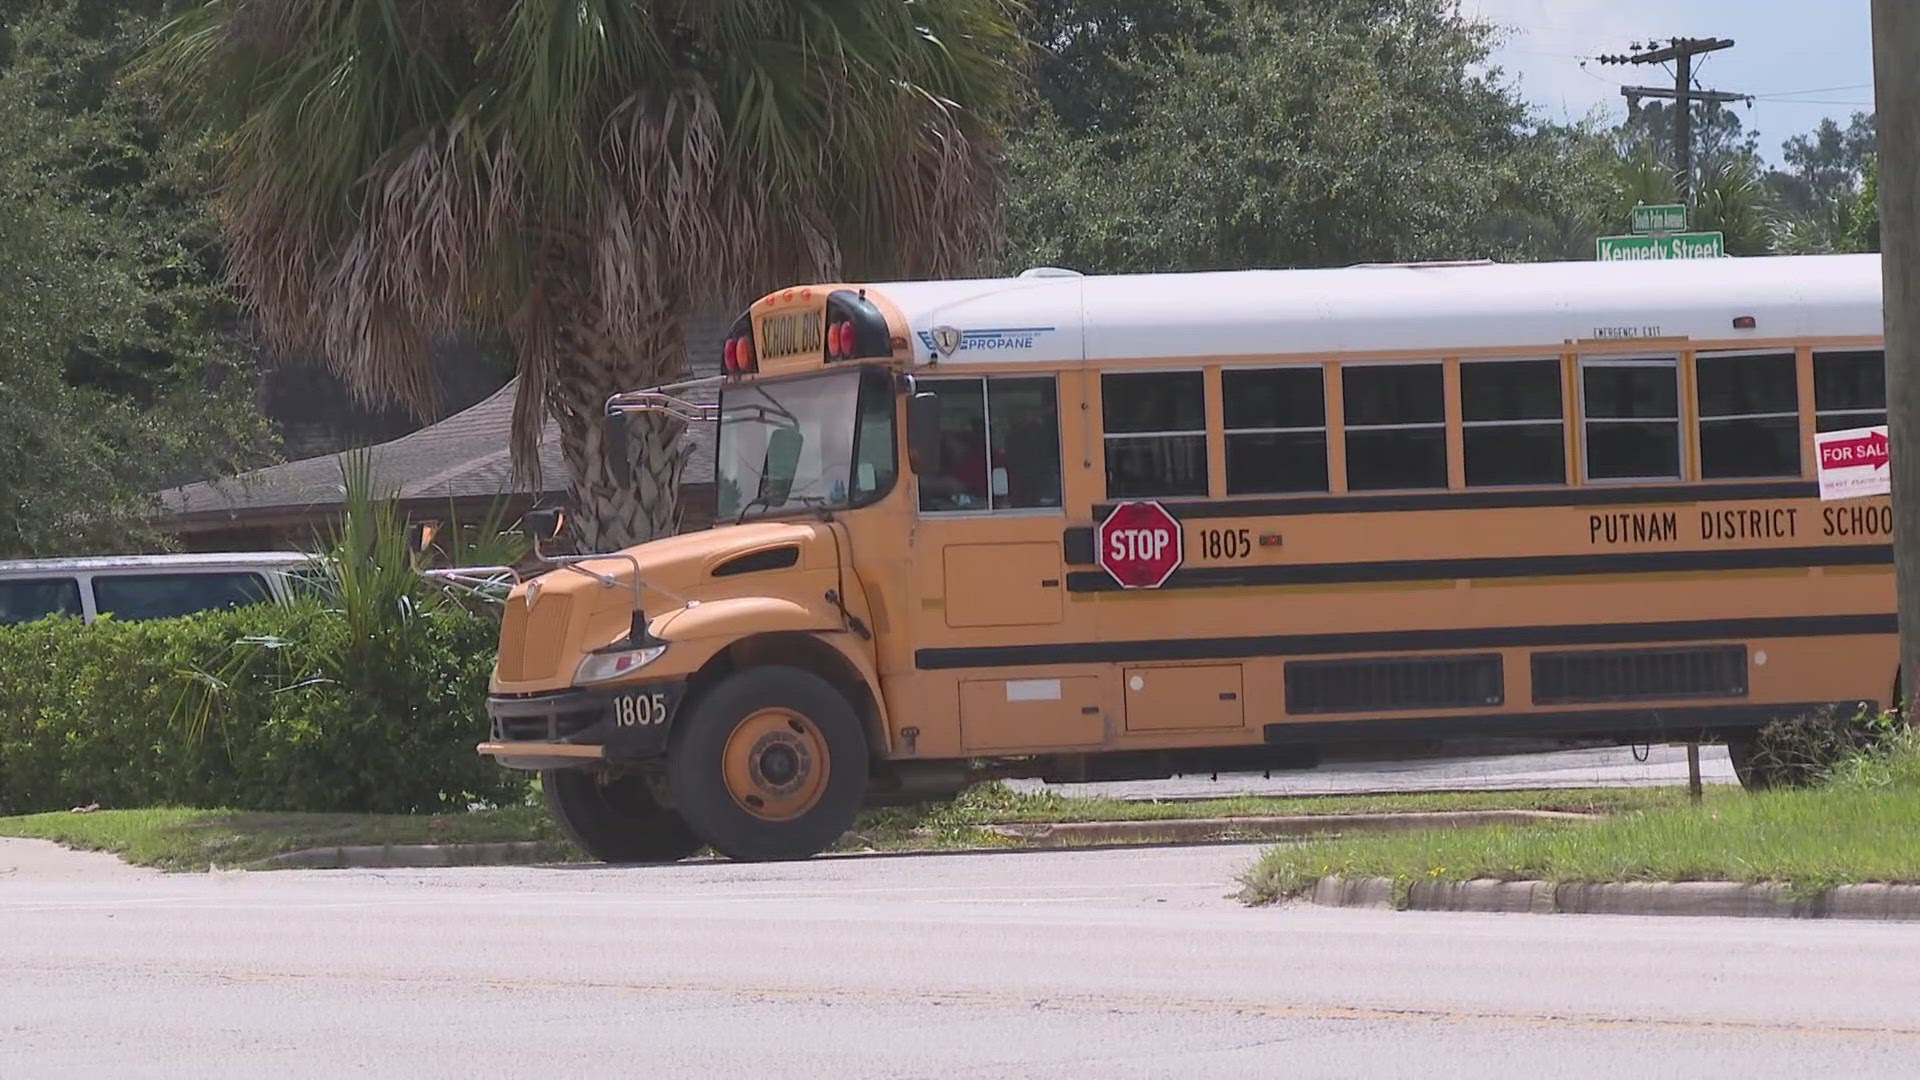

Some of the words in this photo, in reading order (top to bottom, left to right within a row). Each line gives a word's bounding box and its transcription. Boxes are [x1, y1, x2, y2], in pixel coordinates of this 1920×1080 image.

[1601, 240, 1667, 260] Kennedy
[1672, 239, 1718, 259] Street
[762, 315, 798, 358] SCHOOL
[802, 310, 821, 352] BUS
[968, 338, 1033, 350] PROPANE
[1594, 327, 1637, 338] EMERGENCY
[1823, 447, 1853, 462] FOR
[1590, 512, 1677, 544] PUTNAM
[1702, 508, 1797, 540] DISTRICT
[1111, 529, 1169, 561] STOP
[1200, 529, 1251, 559] 1805
[613, 694, 667, 727] 1805
